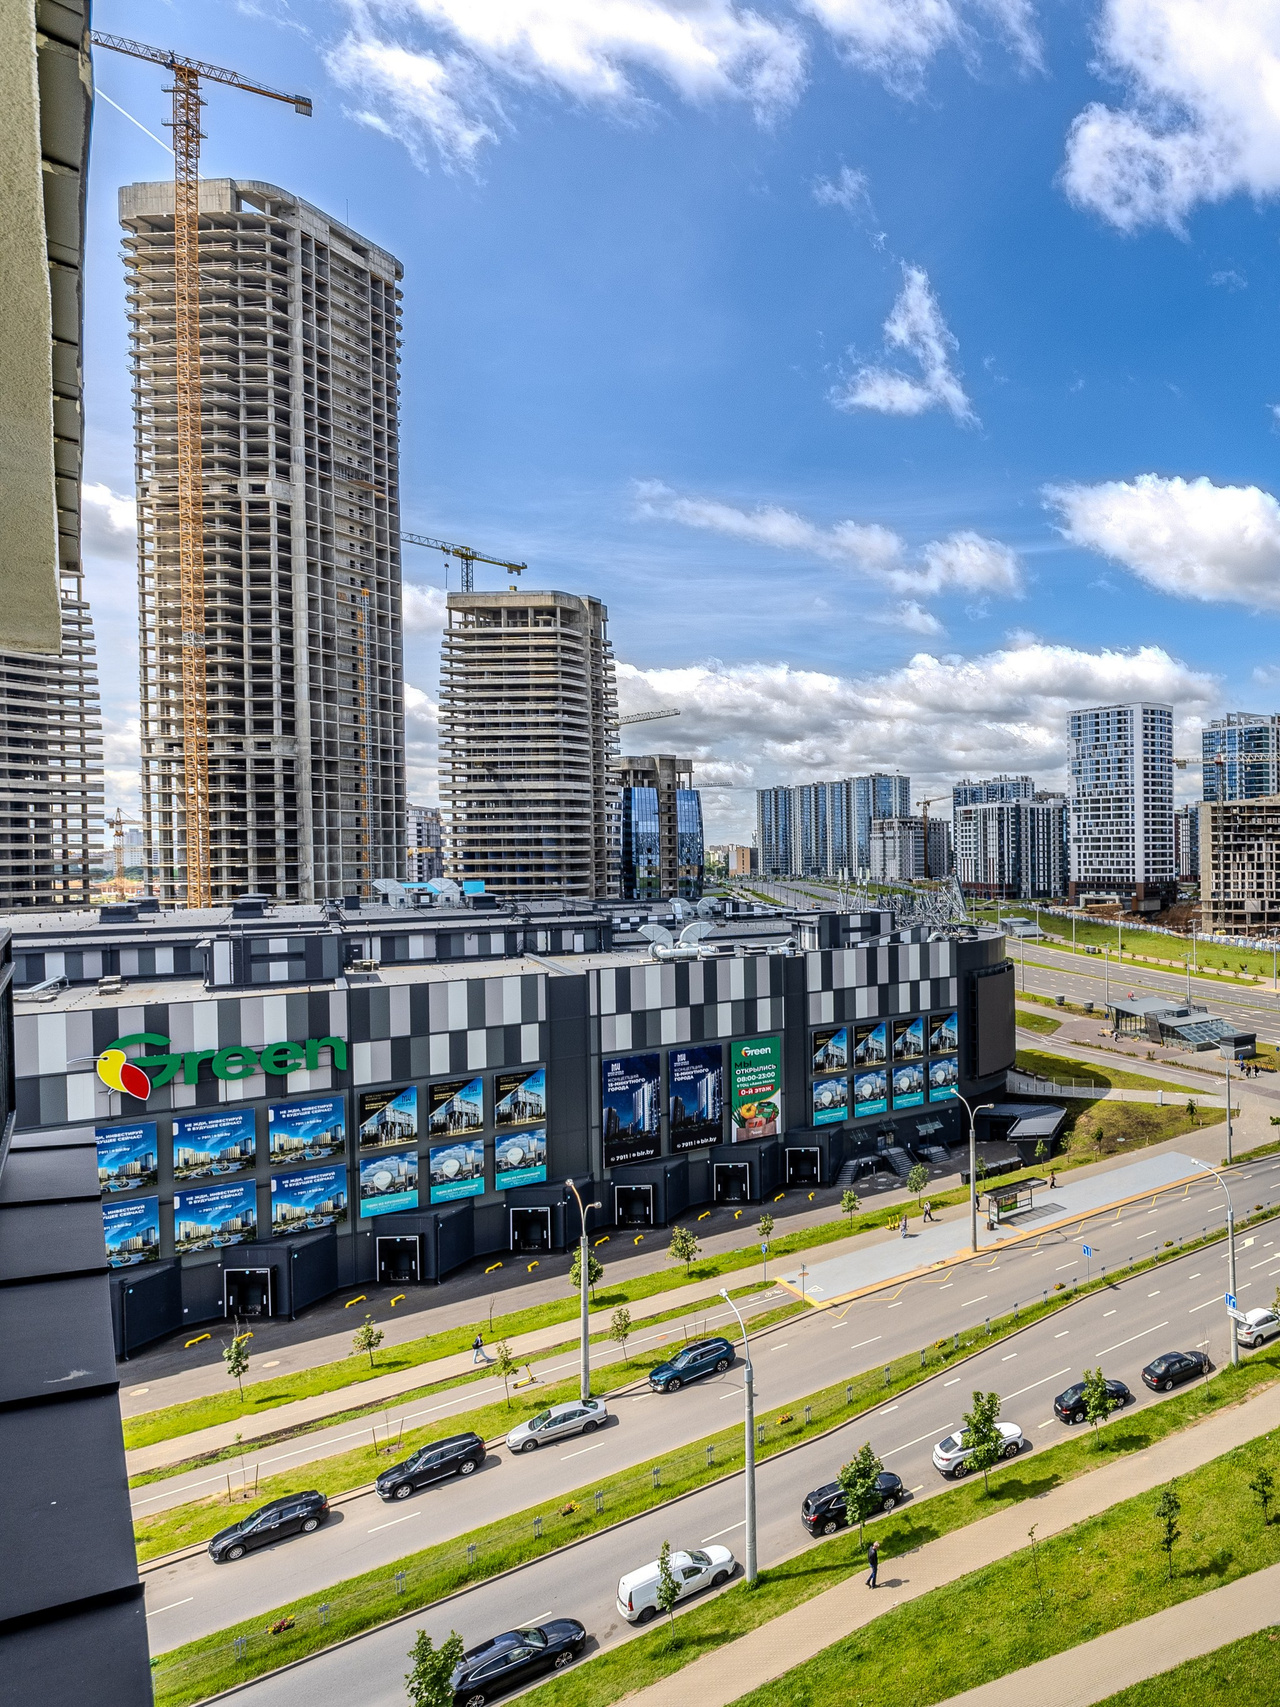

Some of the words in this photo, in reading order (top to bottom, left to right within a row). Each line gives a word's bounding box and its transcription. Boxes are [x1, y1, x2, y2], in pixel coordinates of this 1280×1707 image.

[742, 1046, 771, 1056] Green
[105, 1033, 347, 1089] Green
[736, 1064, 776, 1075] ОТКРЫЛИСЬ
[736, 1072, 776, 1082] 08:00-23:00
[608, 1078, 646, 1088] 15-МИНУТНОГО
[208, 1116, 242, 1124] ИНВЕСТИРУЙ
[106, 1130, 143, 1139] ИНВЕСТИРУЙ
